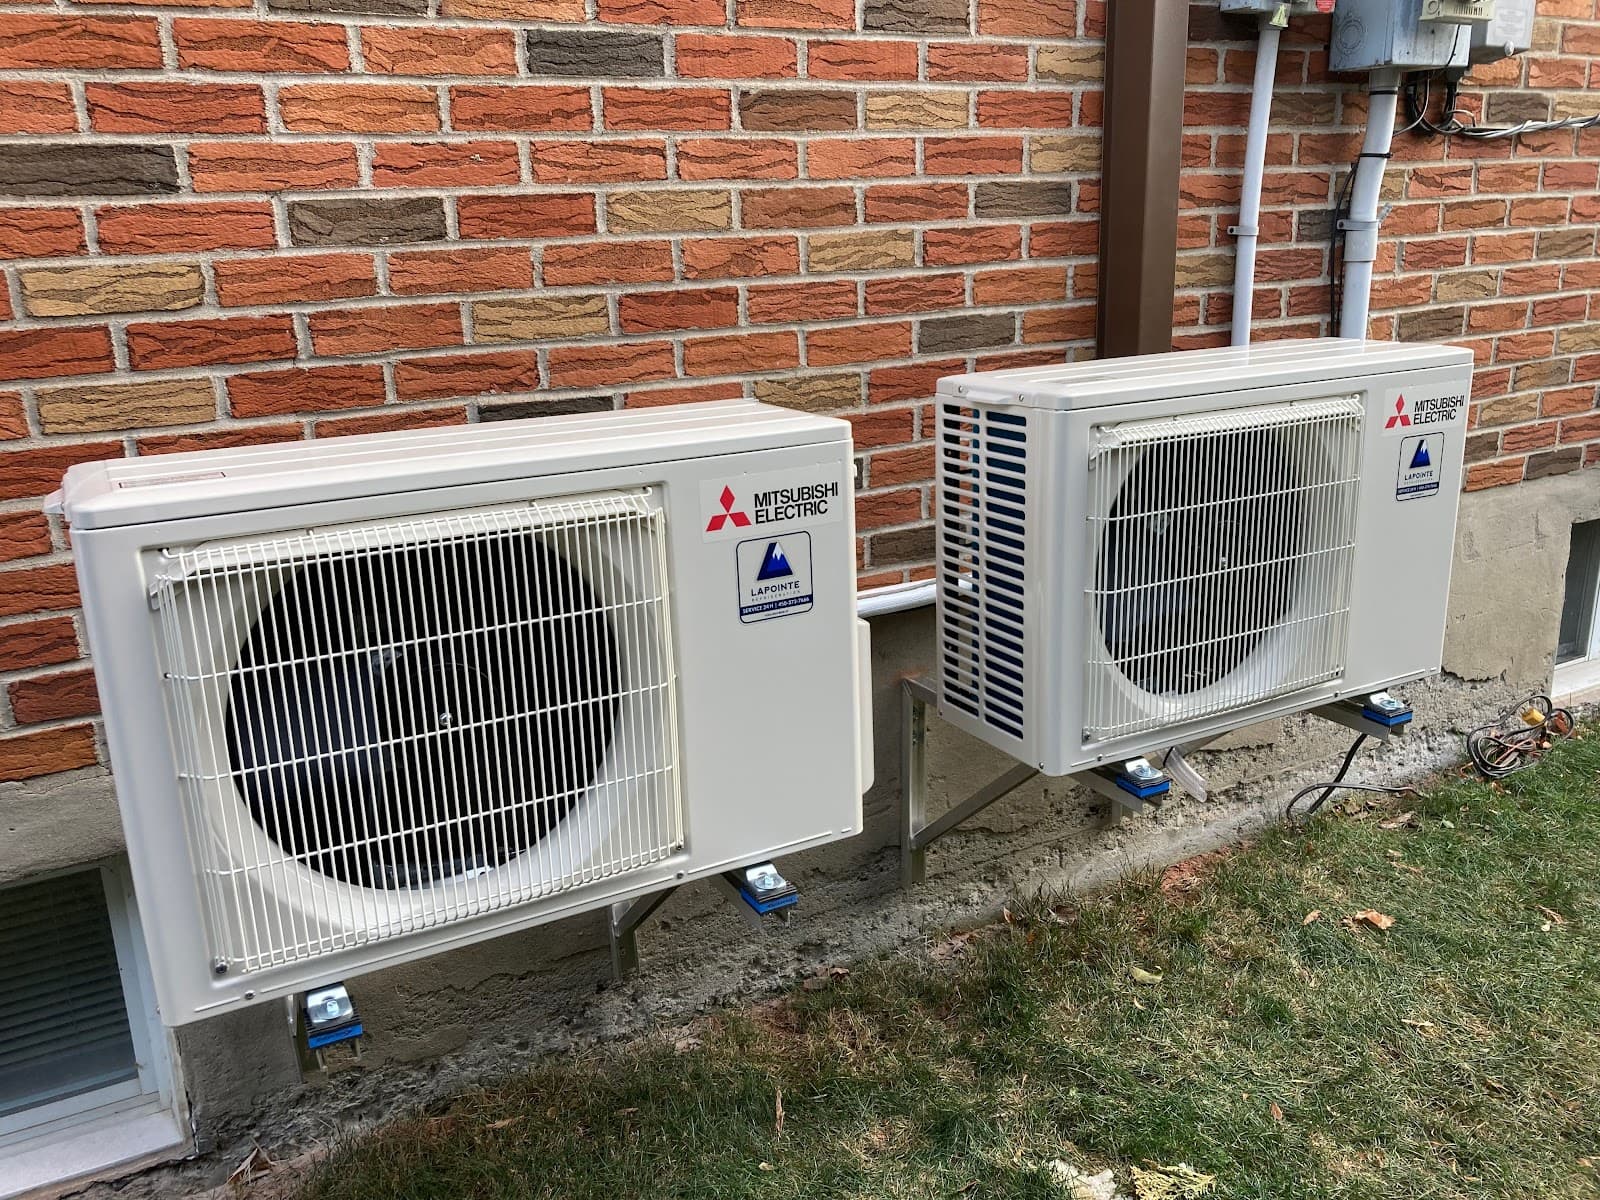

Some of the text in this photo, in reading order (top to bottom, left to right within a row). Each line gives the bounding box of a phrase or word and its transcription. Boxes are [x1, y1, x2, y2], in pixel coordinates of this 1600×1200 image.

[1414, 395, 1465, 412] MITSUBISHI
[1413, 409, 1457, 425] ELECTRIC
[1404, 470, 1434, 481] LAPOINTE
[754, 481, 839, 508] MITSUBISHI
[755, 500, 828, 525] ELECTRIC
[751, 580, 800, 597] LAPOINTE
